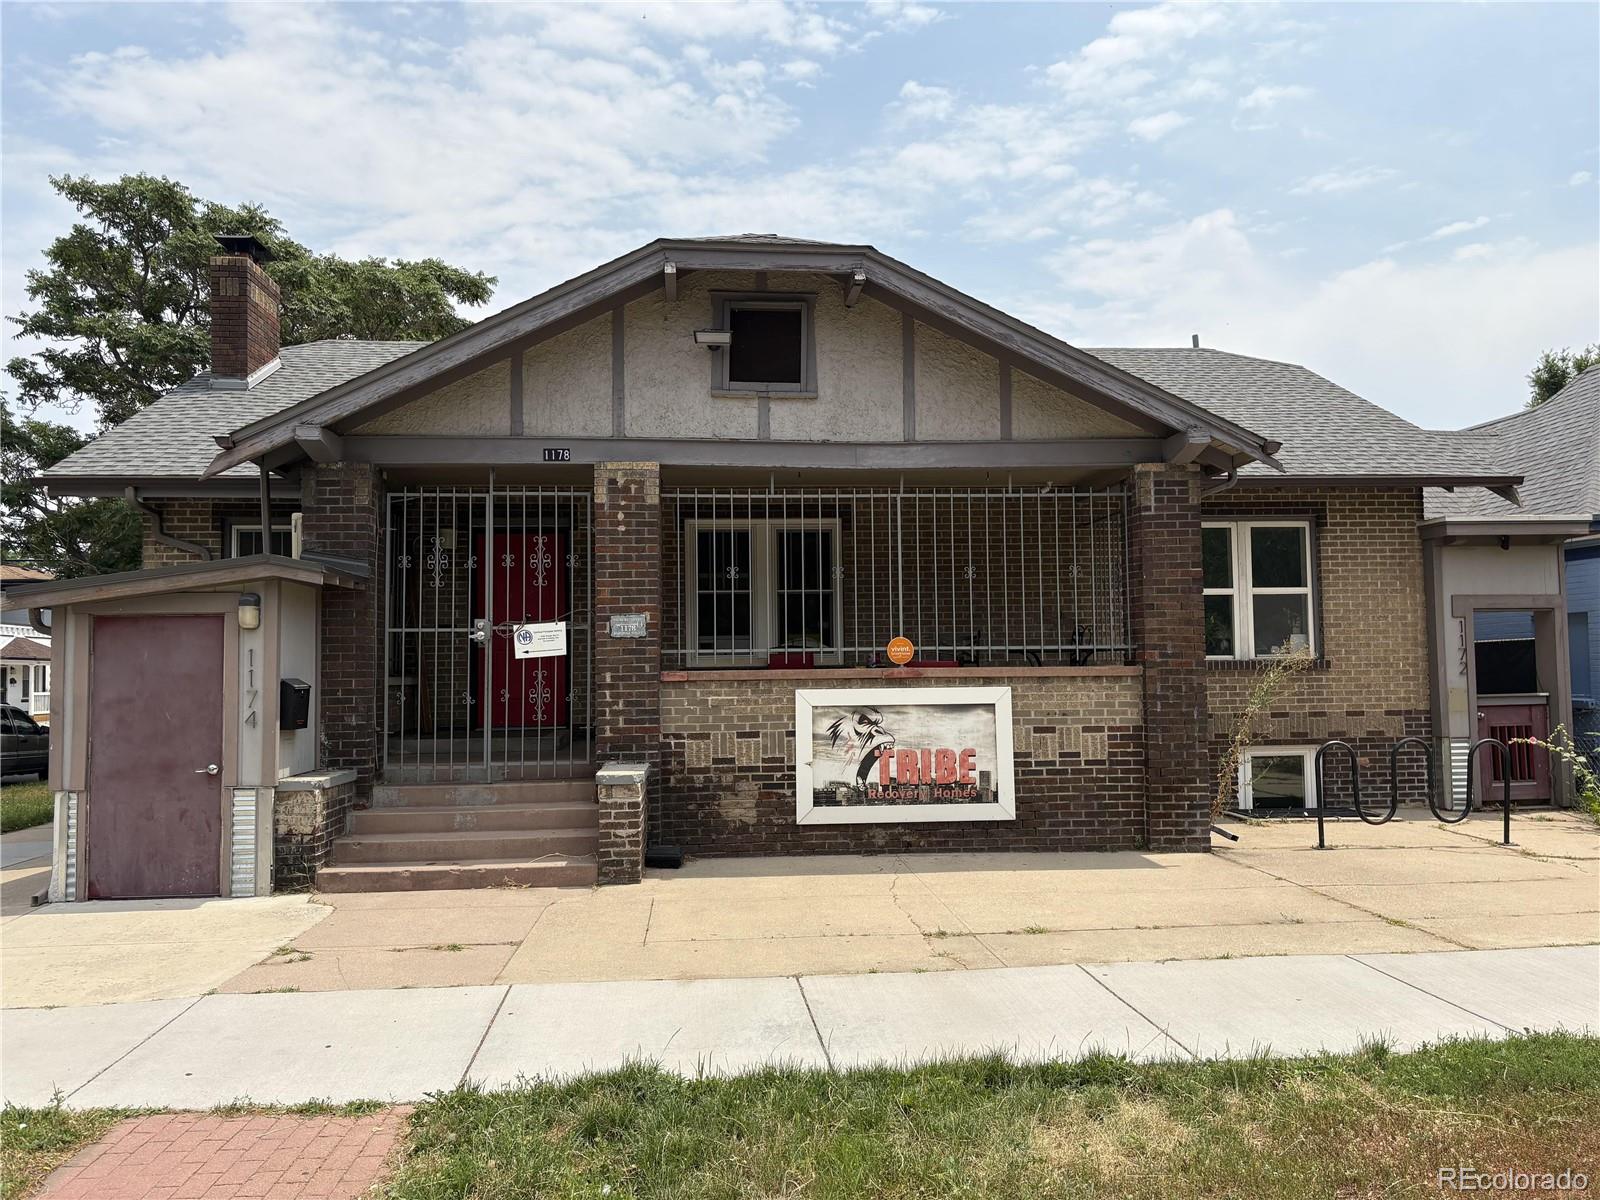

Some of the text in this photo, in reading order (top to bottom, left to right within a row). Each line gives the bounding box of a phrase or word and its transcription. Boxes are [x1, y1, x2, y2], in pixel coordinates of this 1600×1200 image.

[545, 450, 570, 460] 1178
[1458, 620, 1467, 676] 1172
[244, 648, 258, 729] 1174
[874, 748, 977, 787] TRIBE
[933, 787, 978, 799] Homes
